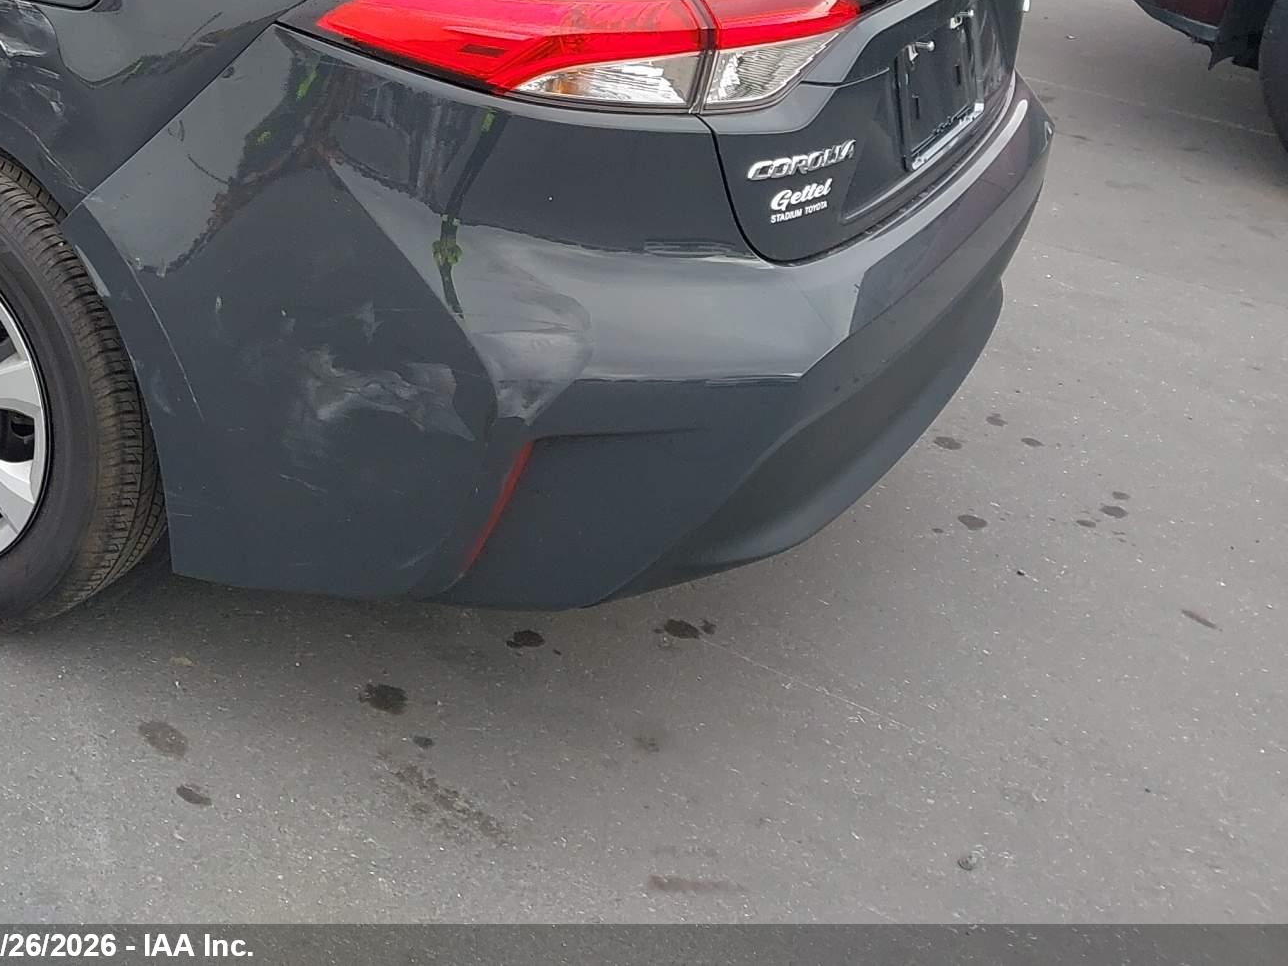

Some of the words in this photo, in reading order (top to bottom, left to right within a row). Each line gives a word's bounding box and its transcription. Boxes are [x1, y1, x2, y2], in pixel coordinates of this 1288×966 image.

[747, 139, 856, 181] COROLLA
[770, 178, 833, 211] Gettel
[770, 209, 802, 224] STADIUM
[804, 201, 828, 216] TOYOTA
